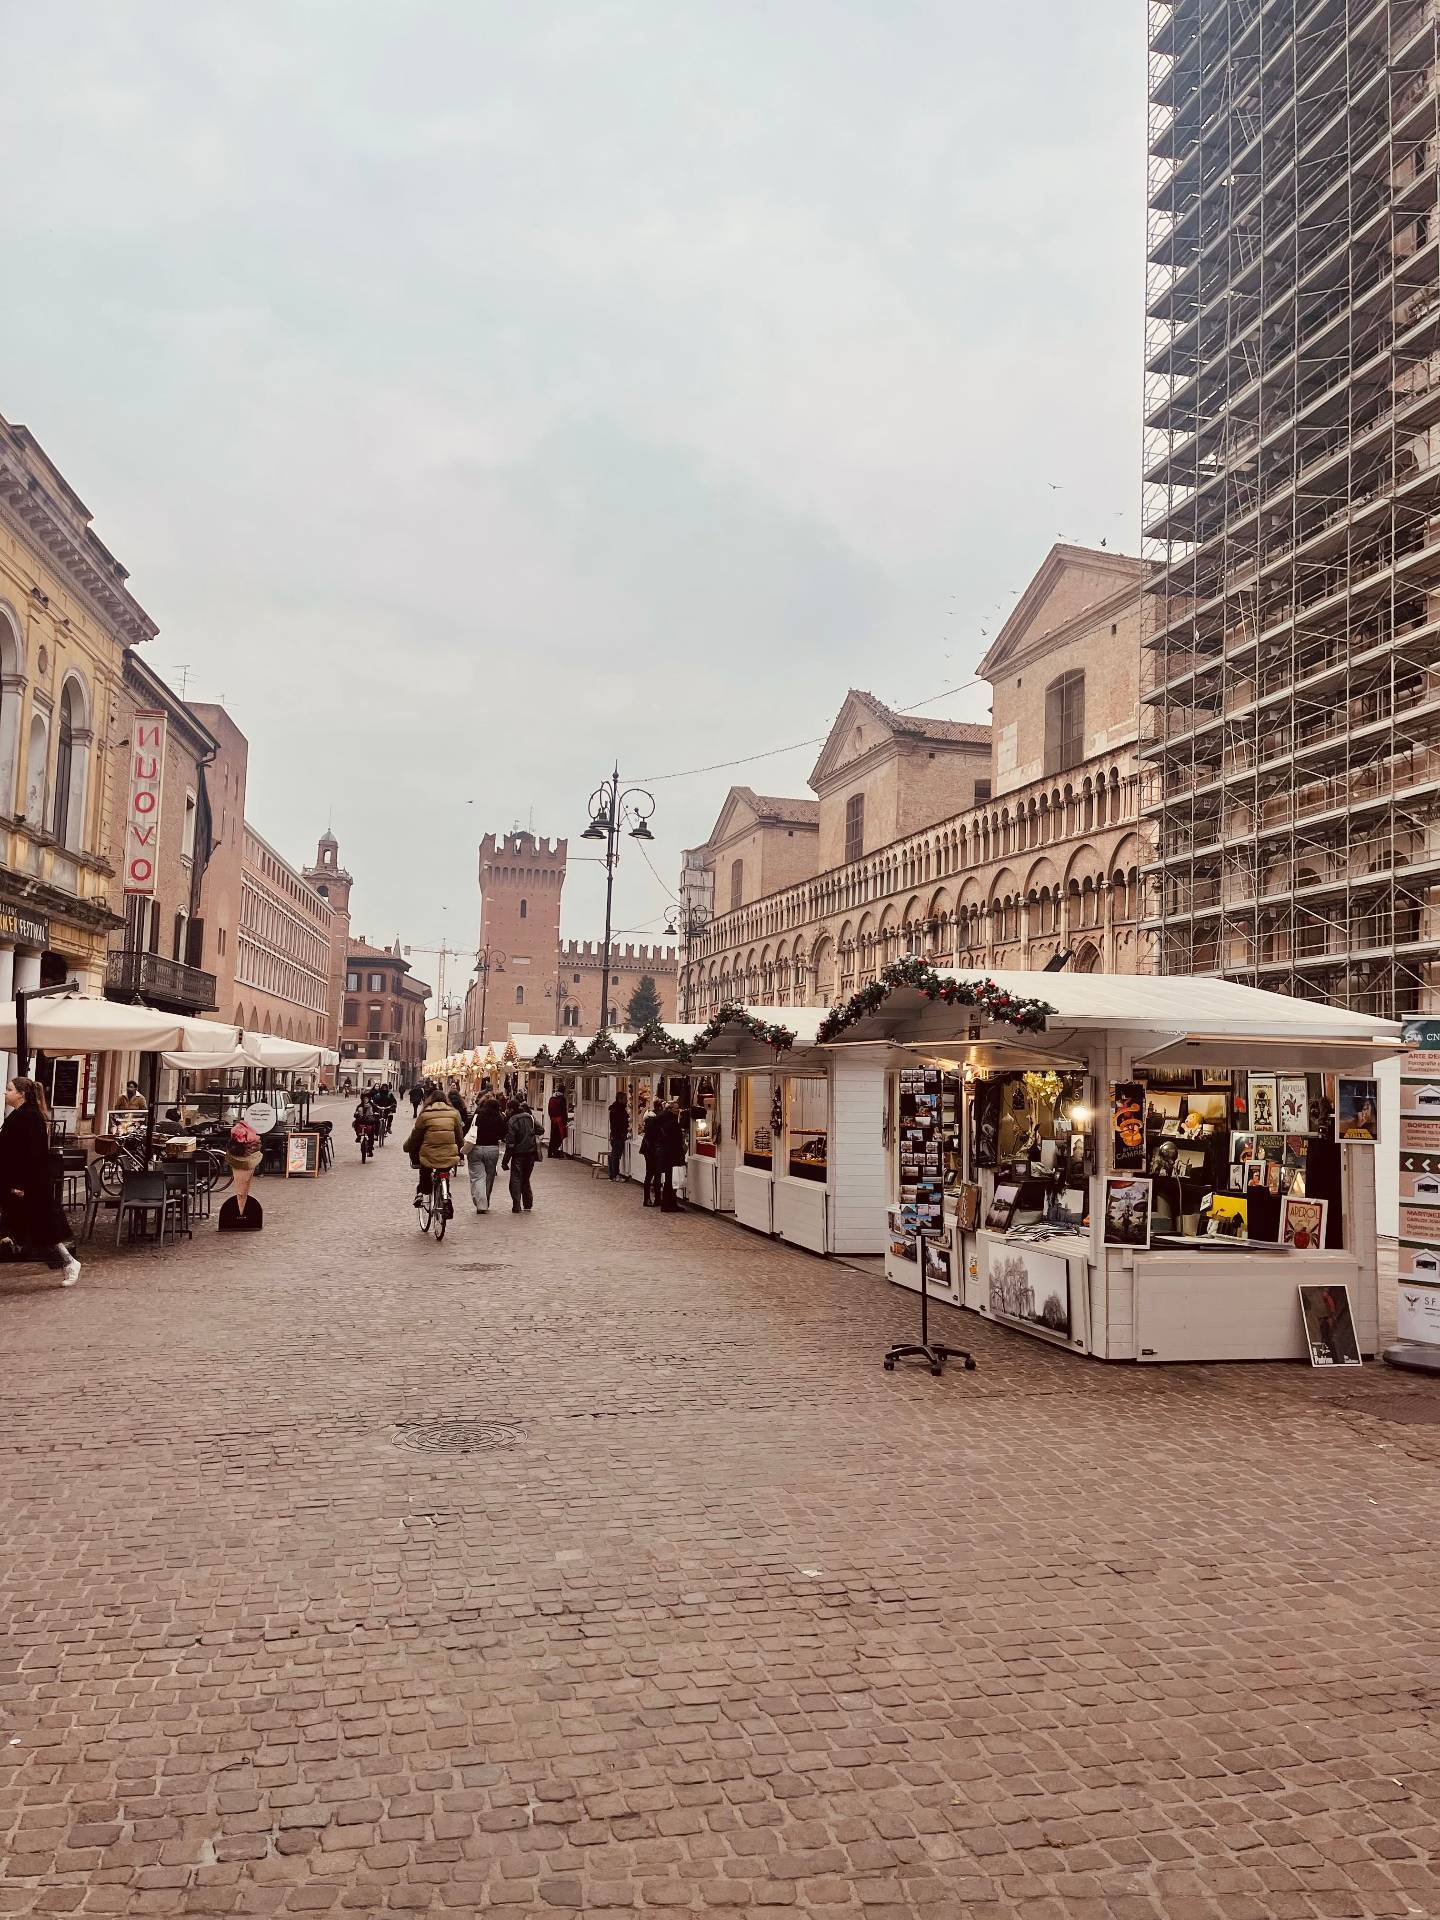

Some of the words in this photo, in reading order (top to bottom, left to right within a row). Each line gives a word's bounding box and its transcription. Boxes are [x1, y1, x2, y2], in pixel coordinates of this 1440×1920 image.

[130, 726, 159, 881] NUOVO
[19, 919, 46, 942] FESTIVAL
[1290, 1206, 1320, 1219] APEROL
